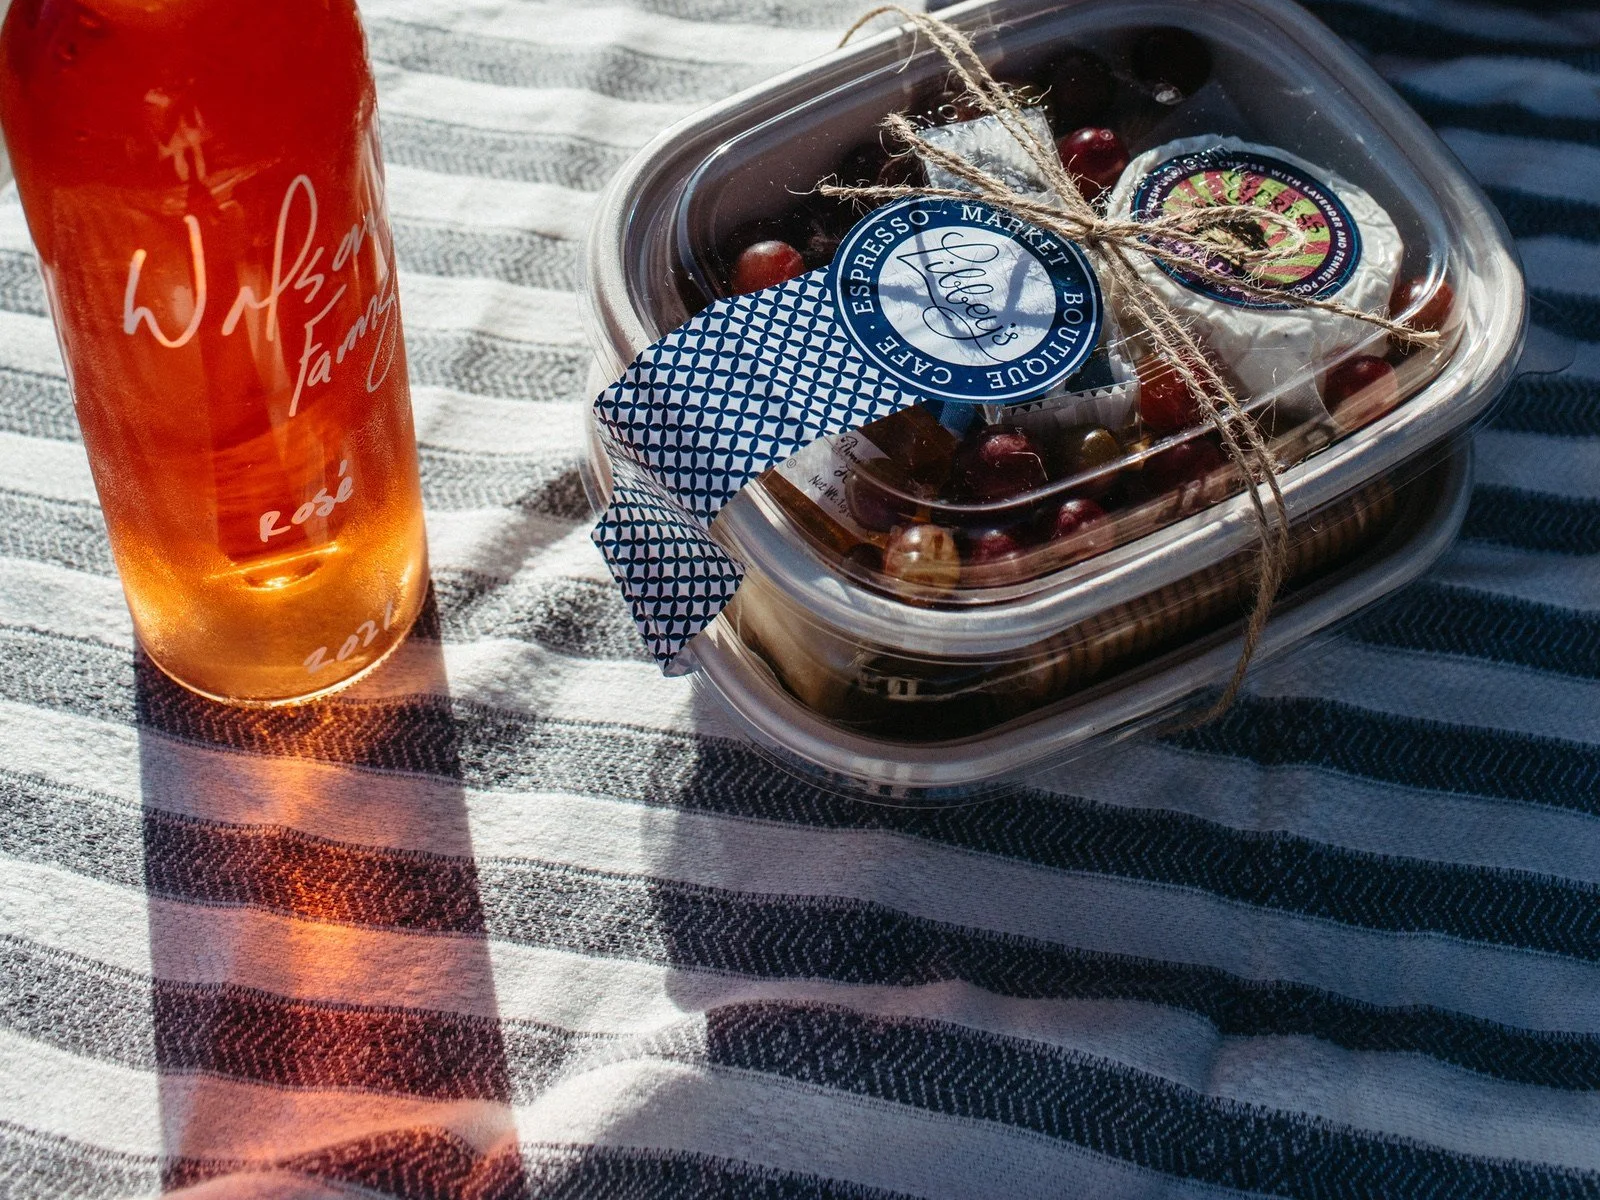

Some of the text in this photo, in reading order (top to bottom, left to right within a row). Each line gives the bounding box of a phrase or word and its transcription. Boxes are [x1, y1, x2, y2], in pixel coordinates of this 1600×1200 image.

[1227, 172, 1326, 235] CYPRESS
[1271, 168, 1301, 187] WITH
[1302, 185, 1343, 228] LAVENDER
[123, 174, 384, 348] Wilson
[850, 209, 929, 315] ESPRESSO
[960, 204, 1069, 266] MARKET
[1317, 249, 1346, 282] FENNEL
[1336, 229, 1348, 249] AND
[896, 232, 1019, 362] Libbey's
[288, 284, 398, 417] Family
[875, 335, 952, 385] CAFE
[986, 291, 1084, 390] BOUTIQUE
[808, 474, 827, 491] Net
[303, 599, 393, 675] 2021
